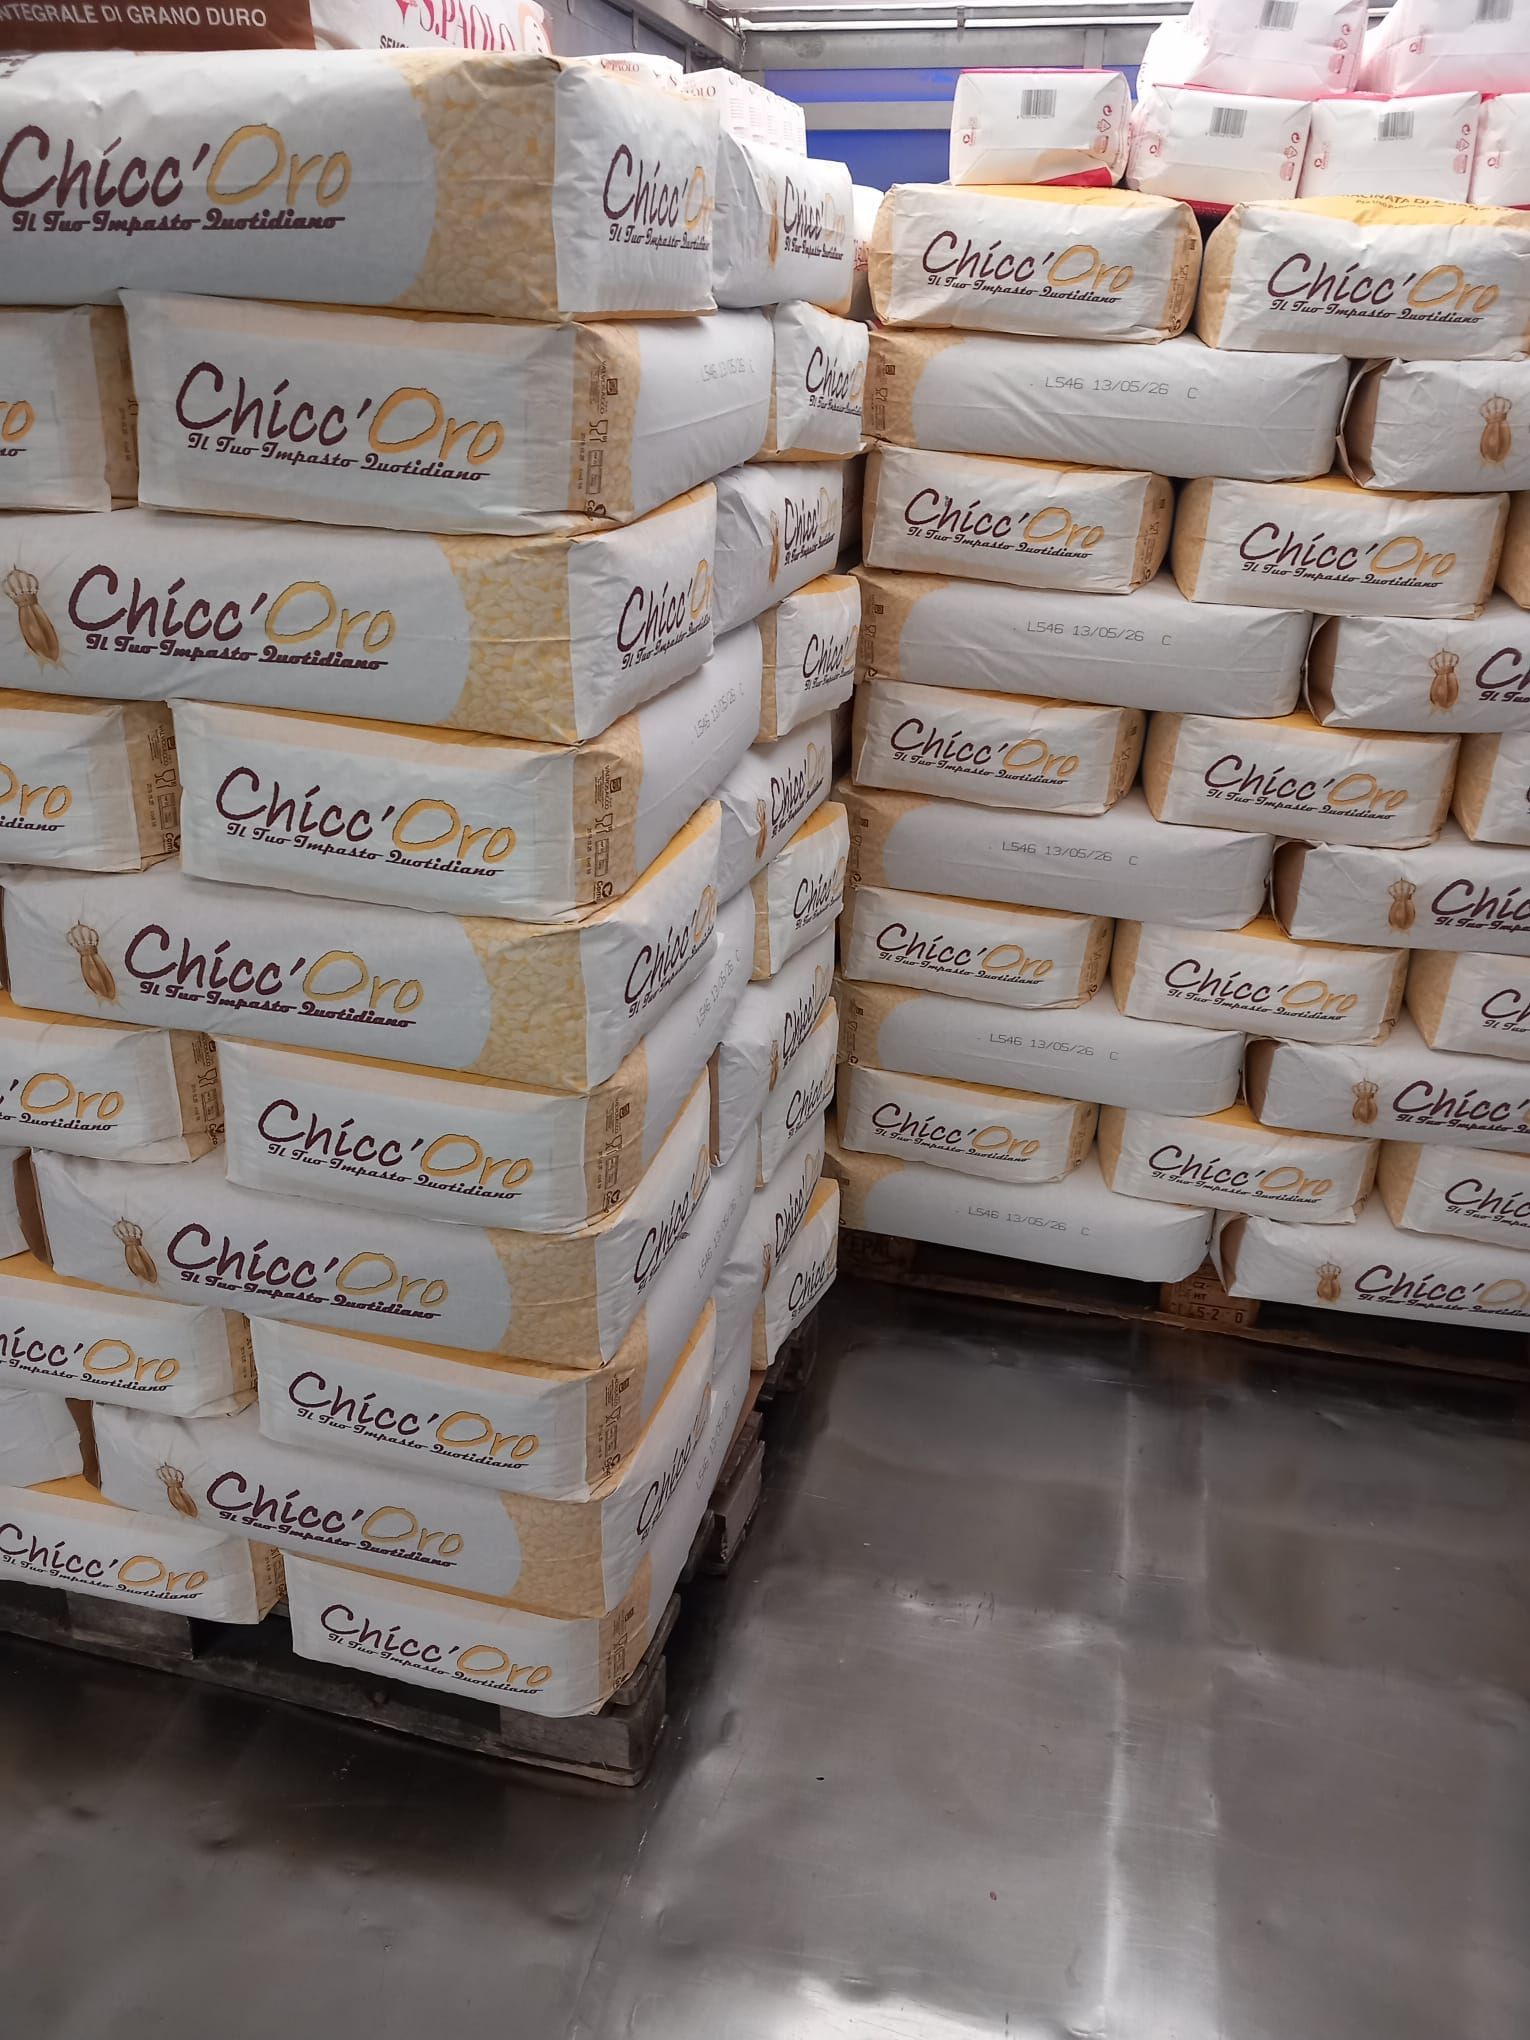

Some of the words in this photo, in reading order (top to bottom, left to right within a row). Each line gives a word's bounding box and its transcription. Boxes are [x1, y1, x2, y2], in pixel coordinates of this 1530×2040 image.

[0, 3, 99, 23] NTEGRALE
[101, 4, 122, 24] DI
[127, 6, 200, 25] GRANO
[207, 7, 267, 27] DURO
[13, 211, 36, 232] Il
[43, 211, 90, 232] Tuo
[92, 211, 200, 236] Impasto
[202, 208, 345, 231] Quotidiano
[928, 275, 941, 285] Il
[944, 277, 972, 289] Tuo
[973, 280, 1037, 296] Impasto
[1038, 287, 1122, 304] Quotidiano
[1269, 299, 1286, 310] Il
[1291, 301, 1324, 313] Tuo
[1325, 304, 1399, 319] Impasto
[1397, 307, 1485, 324] Quotidiano
[1045, 376, 1083, 390] L546
[1092, 379, 1169, 395] 13/05/26
[188, 433, 208, 450] Il
[216, 436, 258, 455] Tuo
[262, 442, 358, 467] Impasto
[360, 453, 490, 481] Quotidiano
[907, 527, 920, 536] Il
[925, 529, 952, 542] Tuo
[953, 534, 1014, 550] Impasto
[1015, 543, 1092, 559] Quotidiano
[1242, 562, 1257, 572] Il
[1262, 564, 1292, 577] Tuo
[1293, 568, 1359, 583] Impasto
[1360, 574, 1443, 588] Quotidiano
[1028, 620, 1064, 634] L546
[1072, 624, 1144, 641] 13/05/26
[86, 633, 107, 650] Il
[115, 636, 157, 654] Tuo
[160, 640, 257, 661] Impasto
[258, 645, 388, 670] Quotidiano
[1479, 690, 1500, 701] Il
[893, 751, 906, 760] Il
[910, 754, 936, 766] Tuo
[936, 759, 994, 776] Impasto
[995, 770, 1068, 785] Quotidiano
[1207, 789, 1221, 799] Il
[1225, 792, 1255, 802] Tuo
[1256, 796, 1318, 812] Impasto
[1319, 805, 1396, 820] Quotidiano
[227, 823, 245, 837] Il
[252, 828, 292, 845] Tuo
[294, 835, 383, 859] Impasto
[385, 850, 504, 877] Quotidiano
[1002, 841, 1036, 854] L546
[1045, 845, 1112, 862] 13/05/26
[1456, 918, 1488, 929] Tuo
[879, 952, 892, 961] Il
[895, 955, 921, 967] Tuo
[921, 960, 976, 977] Impasto
[976, 970, 1044, 985] Quotidiano
[140, 981, 160, 995] Il
[166, 986, 206, 1002] Tuo
[207, 990, 296, 1013] Impasto
[298, 1001, 416, 1027] Quotidiano
[1167, 988, 1182, 997] Il
[1185, 992, 1213, 1003] Tuo
[1213, 997, 1272, 1013] Impasto
[1273, 1005, 1347, 1021] Quotidiano
[990, 1033, 1023, 1046] L546
[1030, 1039, 1094, 1057] 13/05/26
[11, 1112, 117, 1131] Quotidiano
[1416, 1116, 1447, 1126] Tuo
[1447, 1119, 1513, 1131] Impasto
[874, 1128, 889, 1137] Il
[889, 1132, 913, 1143] Tuo
[913, 1137, 965, 1153] Impasto
[965, 1149, 1031, 1163] Quotidiano
[268, 1144, 285, 1157] Il
[292, 1149, 327, 1166] Tuo
[329, 1158, 411, 1183] Impasto
[413, 1175, 521, 1199] Quotidiano
[1151, 1171, 1167, 1181] Il
[1167, 1174, 1195, 1185] Tuo
[1195, 1180, 1251, 1197] Impasto
[1251, 1190, 1322, 1204] Quotidiano
[968, 1207, 999, 1219] L546
[1464, 1208, 1493, 1219] Tuo
[180, 1271, 200, 1283] Il
[205, 1275, 243, 1291] Tuo
[243, 1283, 329, 1303] Impasto
[330, 1295, 440, 1319] Quotidiano
[1405, 1299, 1468, 1312] Impasto
[10, 1359, 78, 1379] Impasto
[80, 1373, 174, 1392] Quotidiano
[297, 1408, 312, 1420] Il
[319, 1415, 351, 1430] Tuo
[353, 1424, 428, 1449] Impasto
[429, 1444, 528, 1469] Quotidiano
[219, 1510, 238, 1522] Il
[240, 1514, 278, 1530] Tuo
[278, 1524, 357, 1549] Impasto
[357, 1540, 457, 1568] Quotidiano
[2, 1555, 17, 1567] Il
[20, 1560, 48, 1574] Tuo
[49, 1568, 113, 1589] Impasto
[114, 1581, 203, 1600] Quotidiano
[328, 1633, 344, 1644] Il
[348, 1639, 378, 1656] Tuo
[379, 1650, 452, 1675] Impasto
[452, 1670, 543, 1695] Quotidiano
